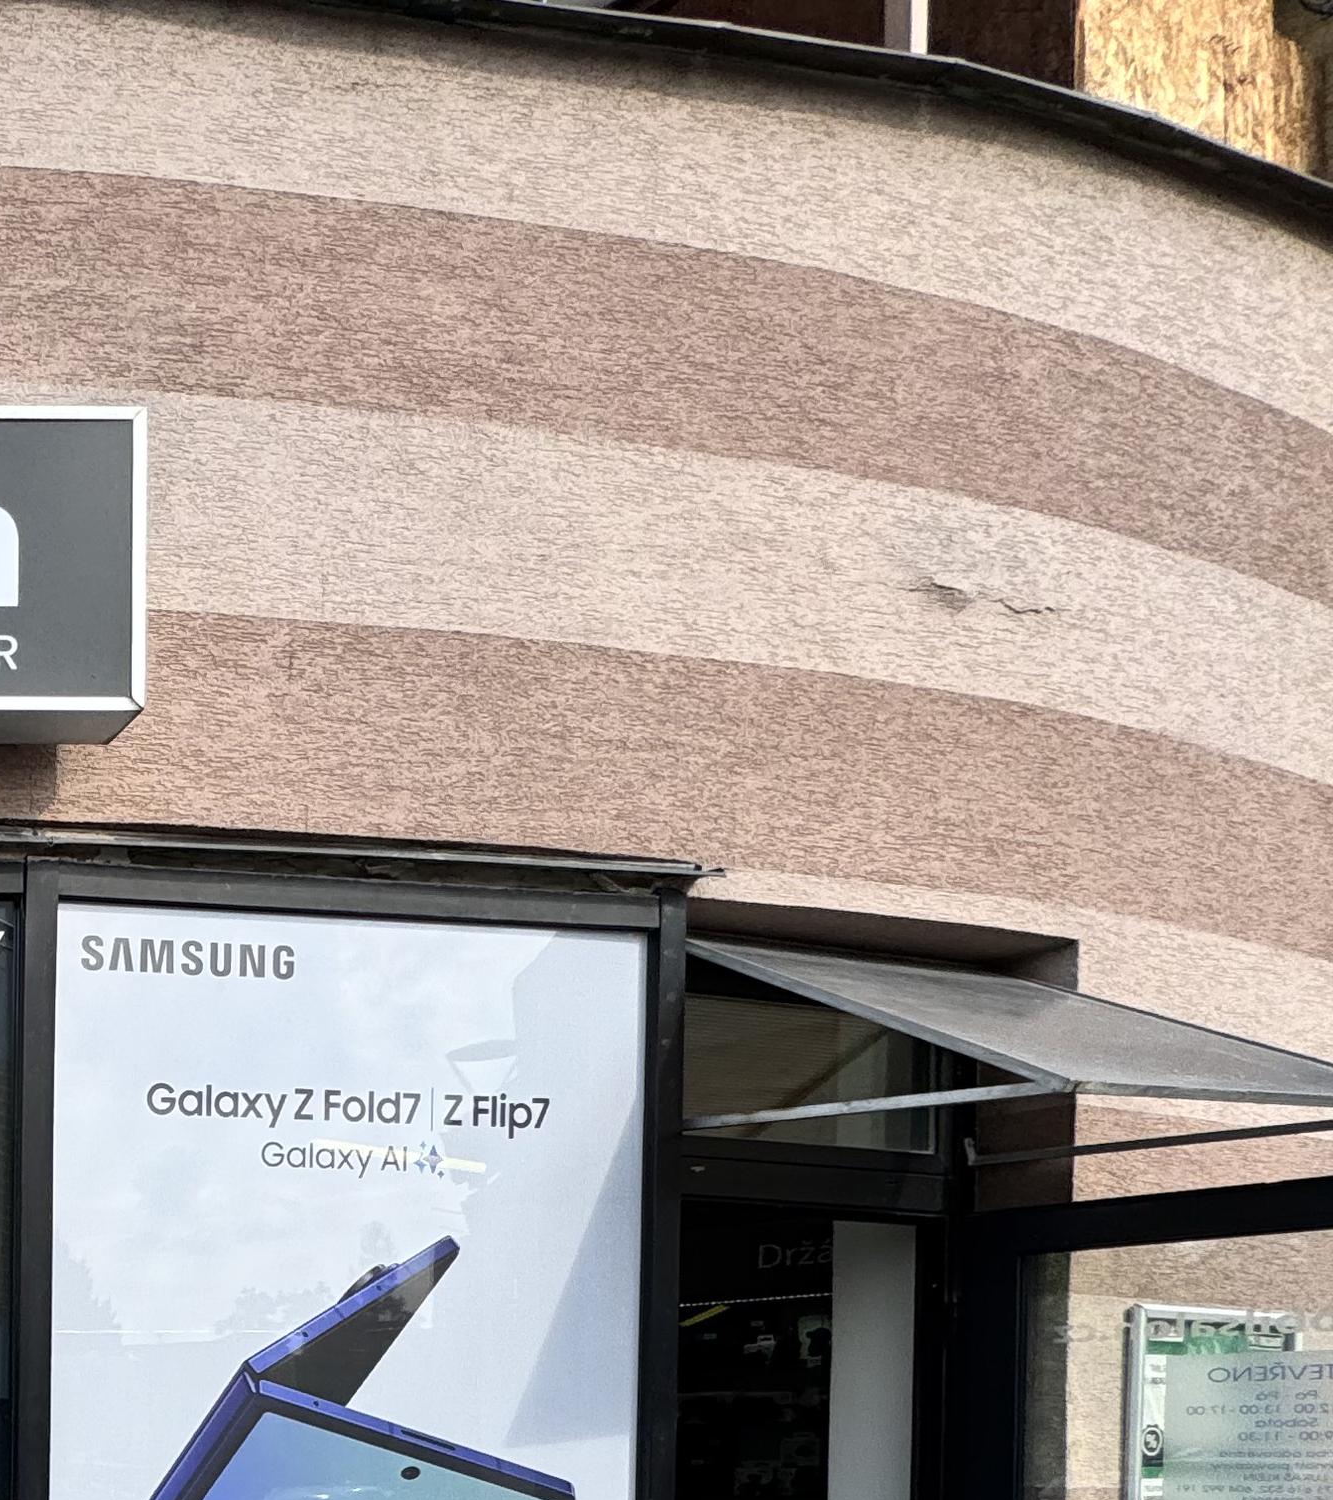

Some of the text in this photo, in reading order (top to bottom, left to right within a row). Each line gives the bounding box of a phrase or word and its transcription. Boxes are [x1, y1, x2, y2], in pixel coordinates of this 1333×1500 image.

[79, 934, 296, 980] SAMSUNG
[145, 1081, 551, 1139] Galaxy Z Fold7 Z Flip7
[260, 1140, 409, 1178] Galaxy AI
